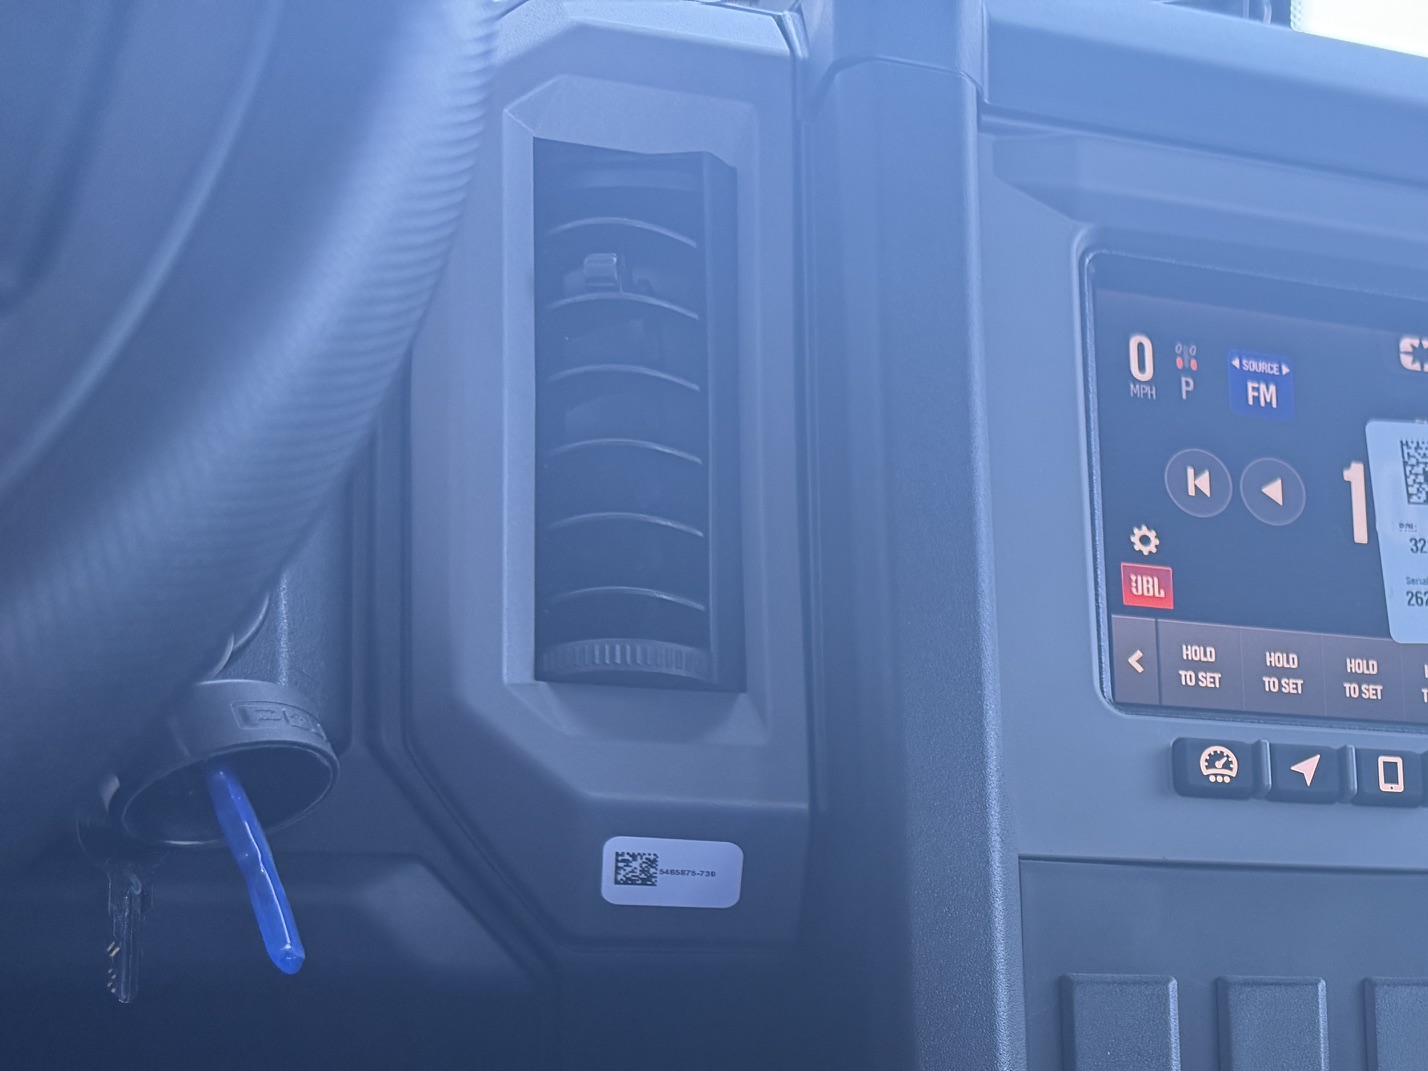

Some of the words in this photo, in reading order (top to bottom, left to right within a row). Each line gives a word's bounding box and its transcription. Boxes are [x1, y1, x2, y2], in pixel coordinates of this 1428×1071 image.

[1129, 333, 1154, 382] 0
[1242, 358, 1280, 375] SOURCE
[1130, 384, 1156, 400] MPH
[1180, 376, 1195, 400] P
[1247, 381, 1278, 409] FM
[1130, 574, 1165, 598] JBL
[1182, 644, 1216, 662] HOLD
[1265, 651, 1298, 669] HOLD
[1346, 658, 1378, 675] HOLD
[1179, 670, 1196, 687] TO
[1198, 671, 1222, 688] SET
[1262, 676, 1279, 693] TO
[1281, 677, 1304, 694] SET
[1343, 682, 1360, 698] TO
[1361, 684, 1383, 700] SET
